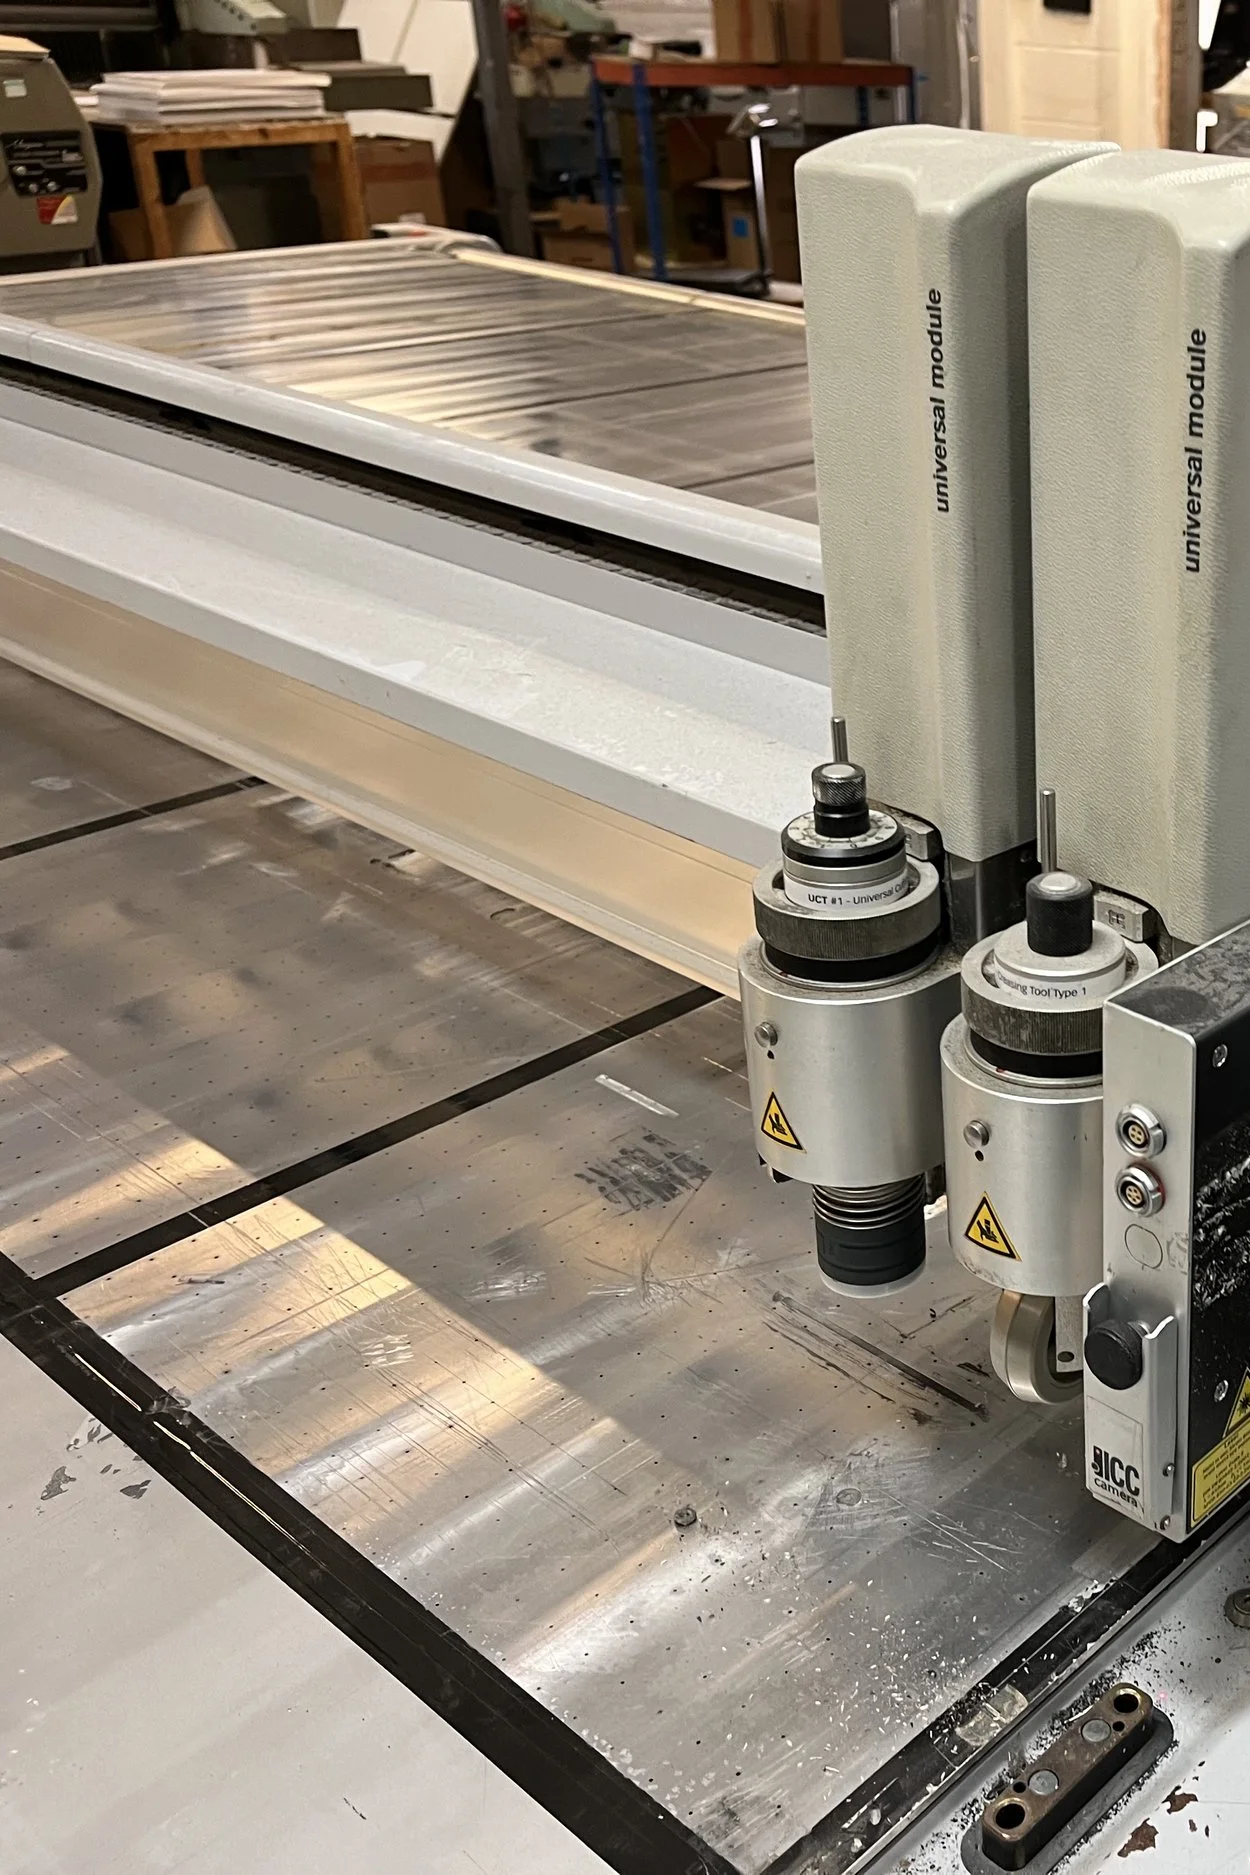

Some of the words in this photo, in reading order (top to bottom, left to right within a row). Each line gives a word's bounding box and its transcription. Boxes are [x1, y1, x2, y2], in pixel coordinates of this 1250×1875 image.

[926, 288, 944, 389] module
[1186, 328, 1207, 438] module
[930, 397, 949, 513] universal
[1183, 446, 1203, 573] universal
[808, 893, 827, 905] UCT
[853, 886, 894, 905] Universal
[1030, 985, 1051, 998] Tool
[1054, 988, 1078, 1000] Type
[1094, 1477, 1138, 1508] camera
